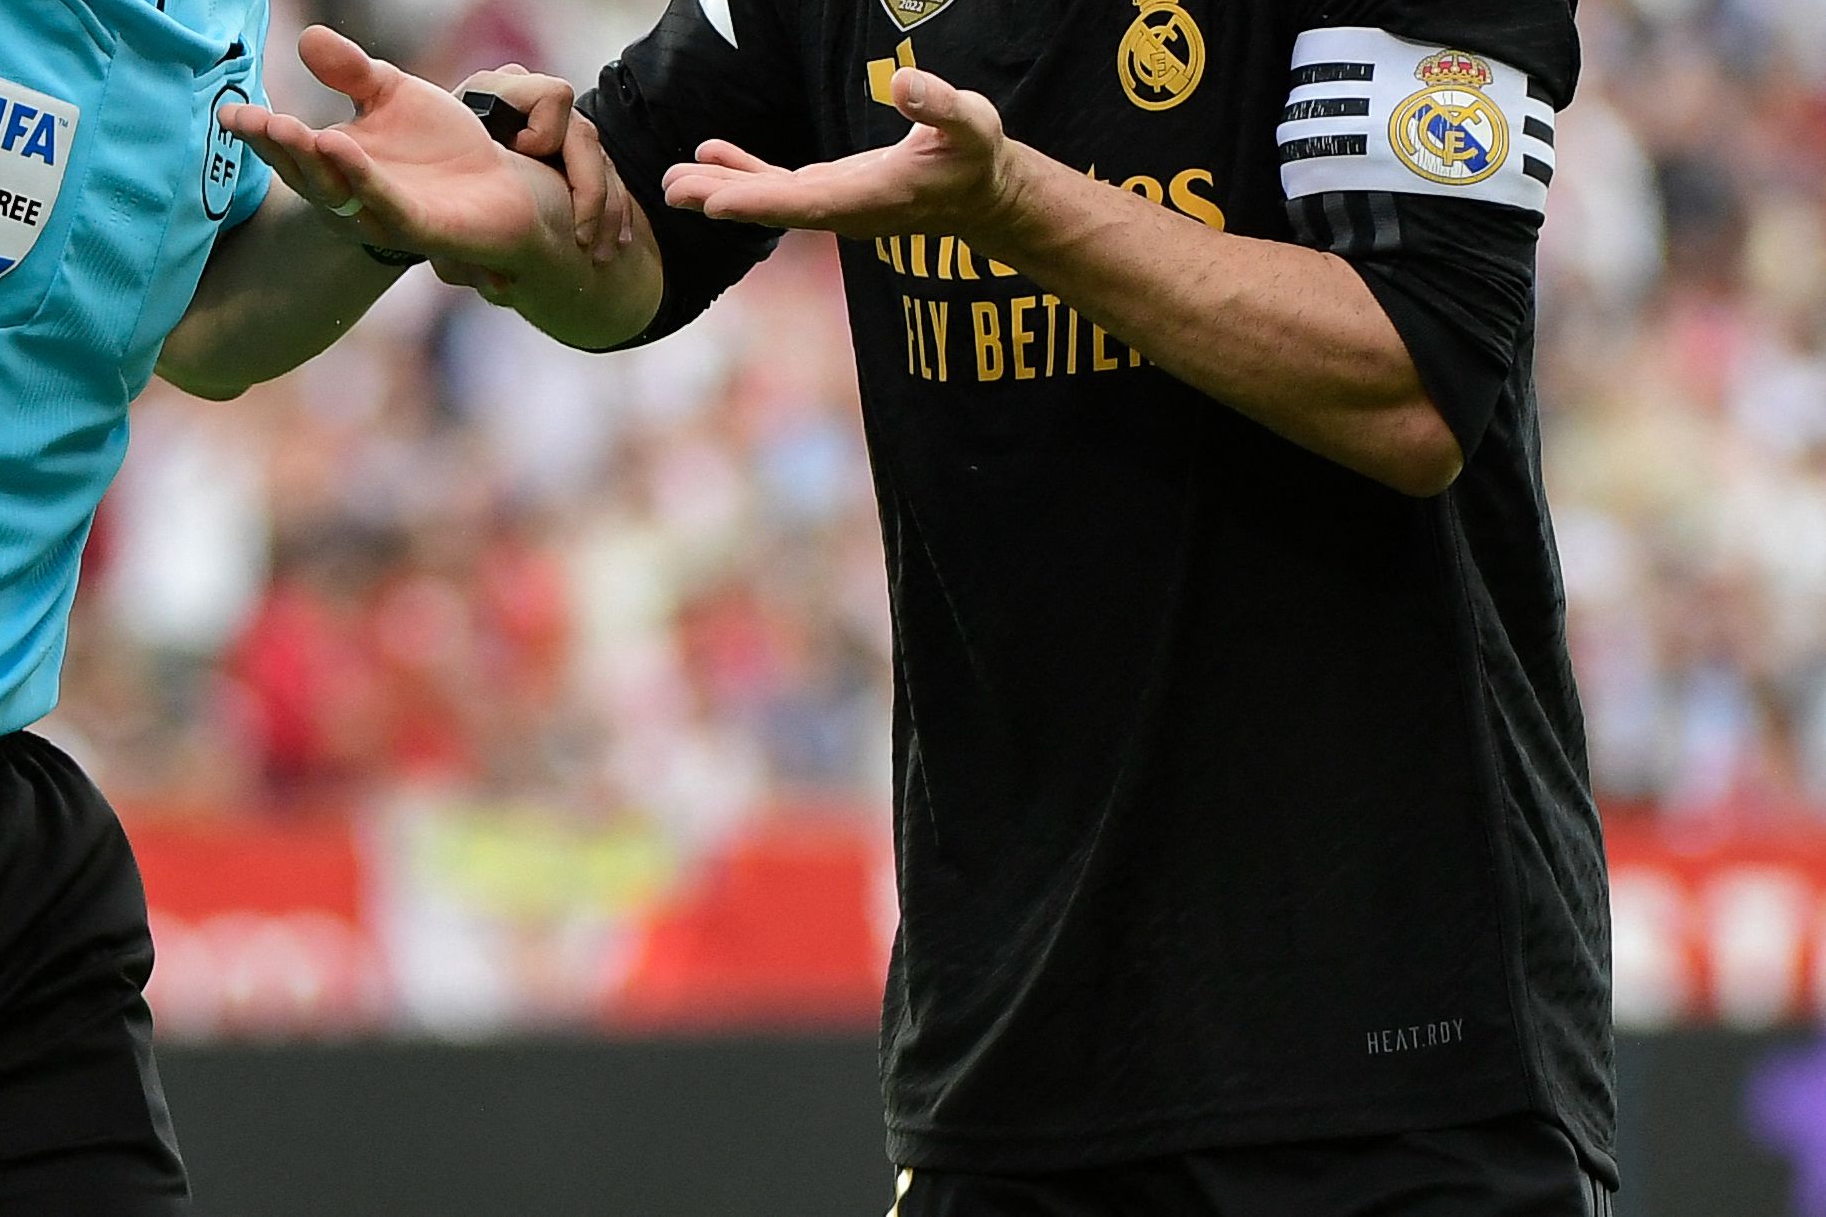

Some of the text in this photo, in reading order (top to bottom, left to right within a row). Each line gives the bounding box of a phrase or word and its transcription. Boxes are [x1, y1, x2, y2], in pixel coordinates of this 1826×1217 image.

[898, 0, 924, 13] 2022
[902, 293, 1155, 382] FLY BETTE
[1366, 1018, 1463, 1055] HEAT.RDY
